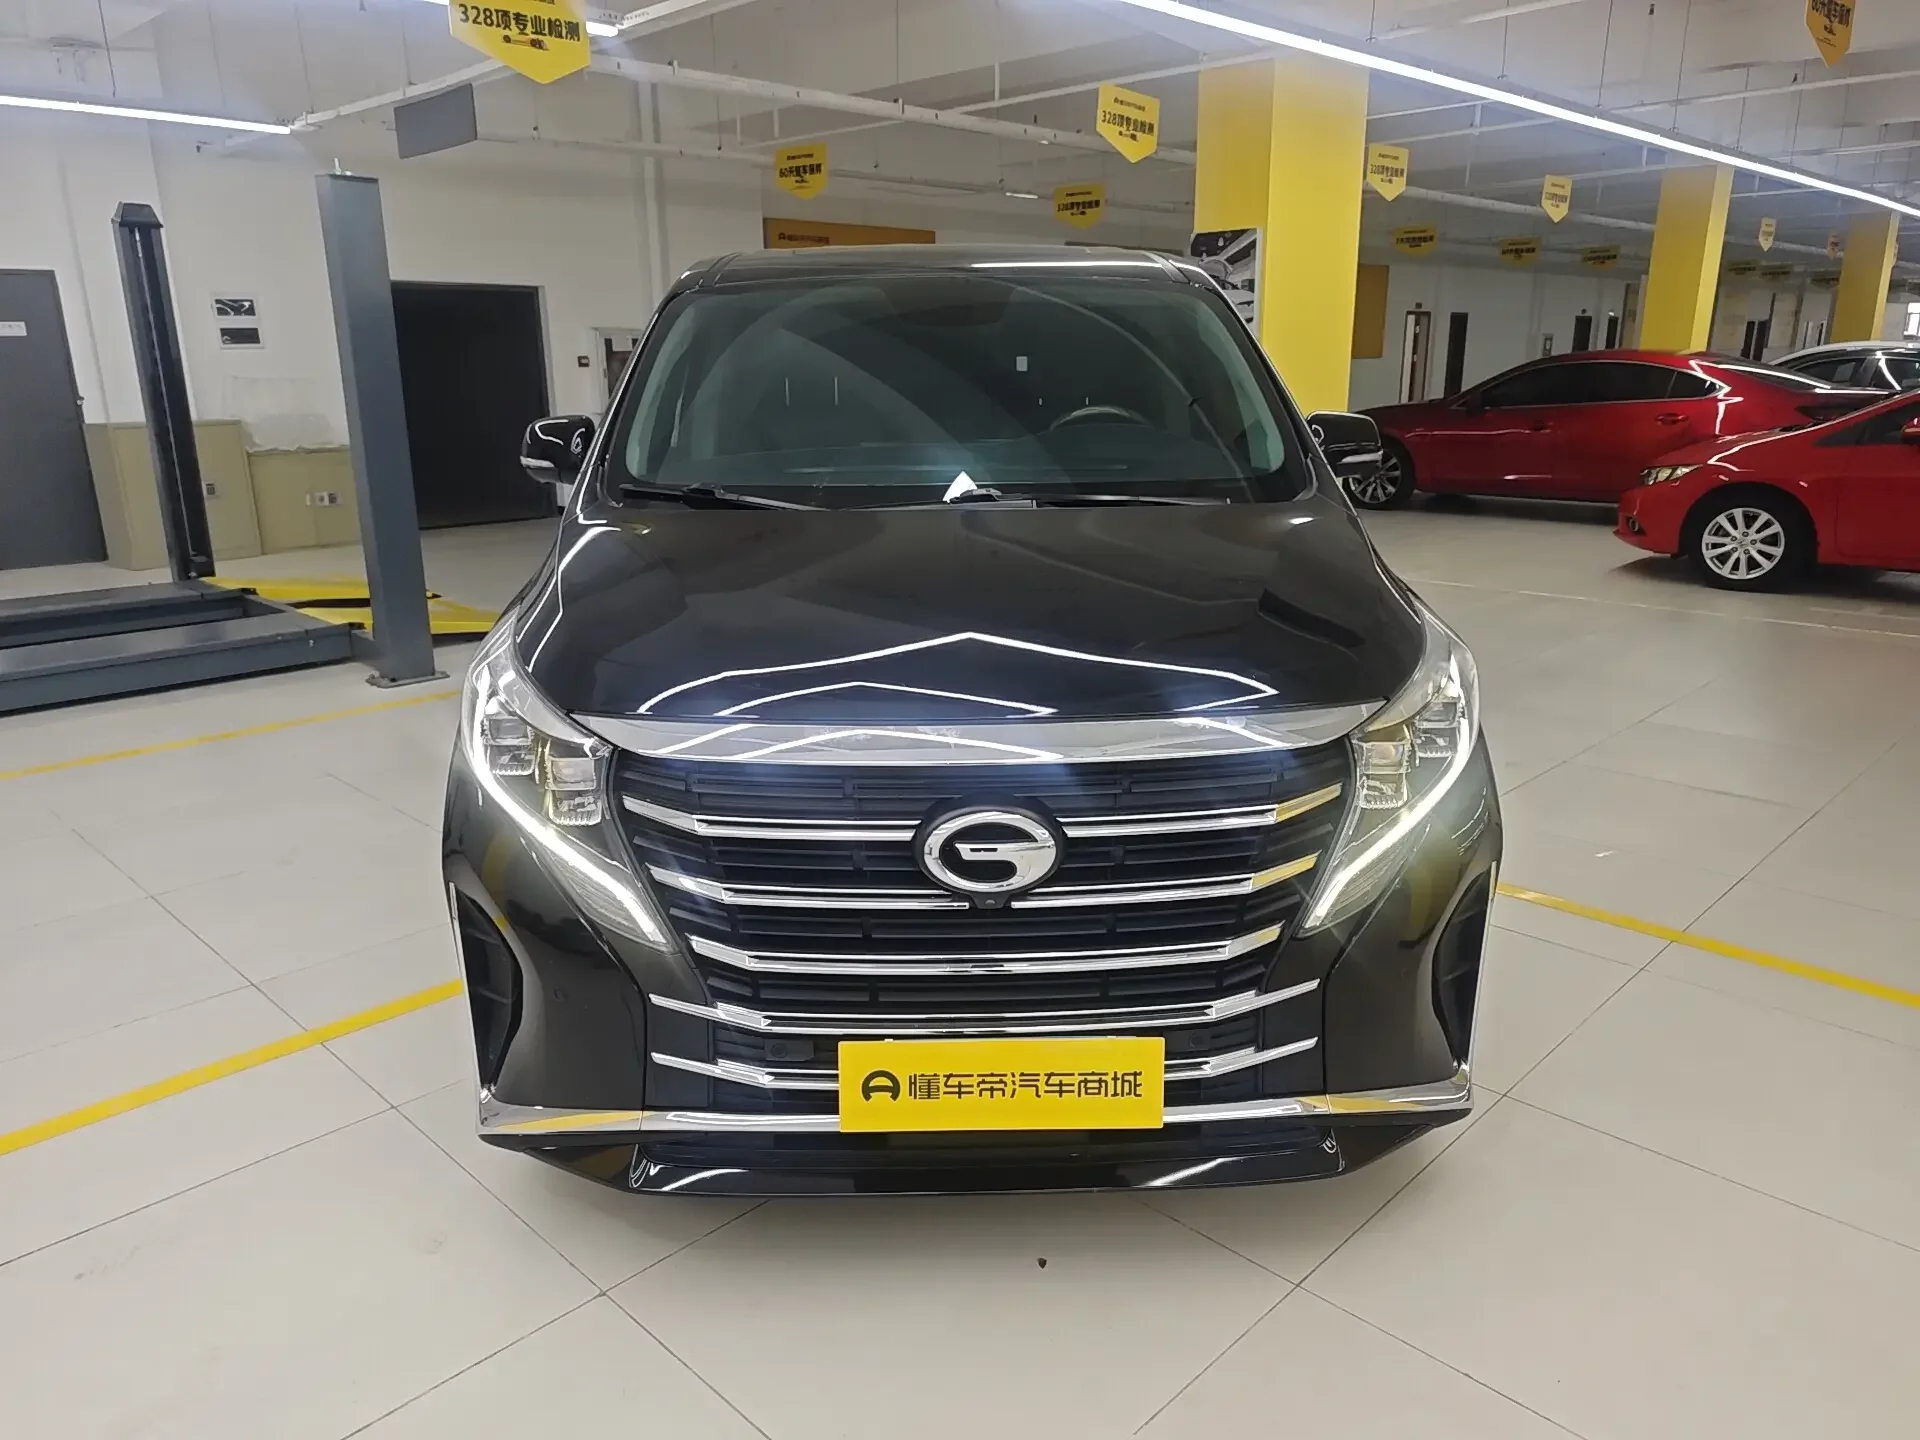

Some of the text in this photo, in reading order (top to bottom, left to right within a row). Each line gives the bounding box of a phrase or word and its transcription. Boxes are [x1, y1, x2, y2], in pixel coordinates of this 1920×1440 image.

[458, 3, 581, 43] 328项专业检测
[908, 1070, 1143, 1100] 懂车帝汽车商城
